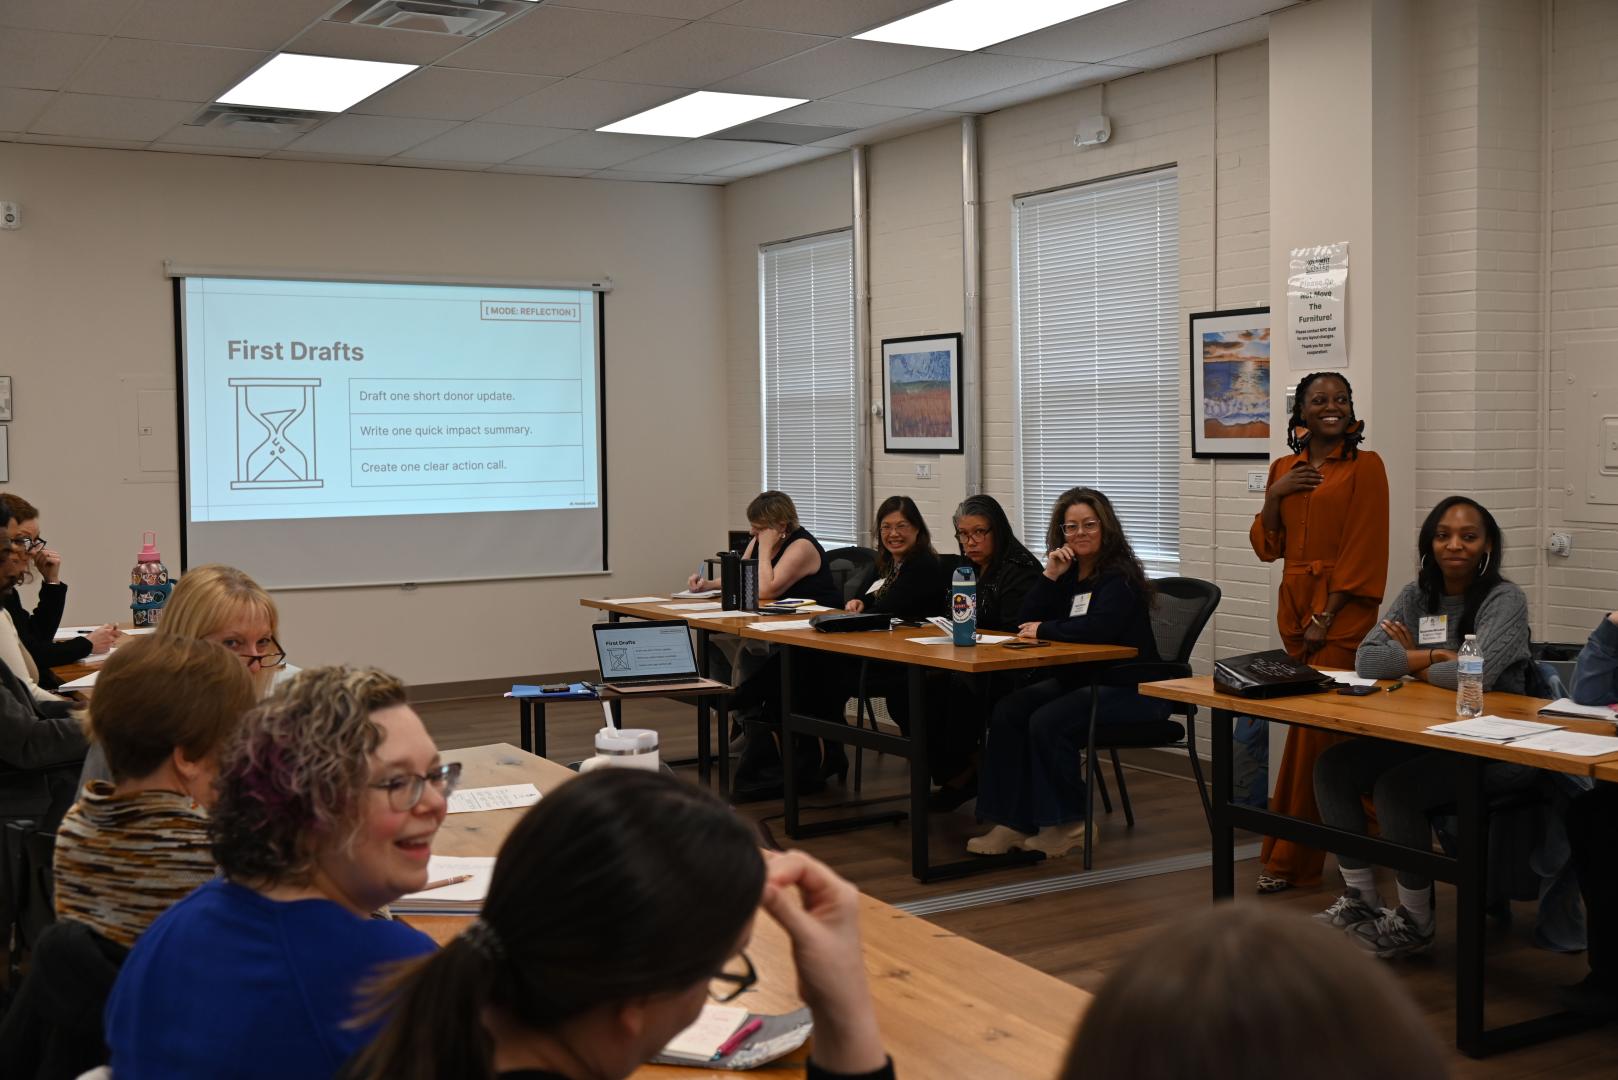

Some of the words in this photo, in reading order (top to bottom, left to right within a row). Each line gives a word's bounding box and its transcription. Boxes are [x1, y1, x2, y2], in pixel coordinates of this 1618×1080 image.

[490, 306, 519, 316] MODE:
[520, 307, 572, 317] REFLECTION
[1298, 314, 1332, 324] Furniture!
[228, 339, 284, 361] First
[290, 341, 365, 361] Drafts
[359, 390, 387, 401] Draft
[389, 392, 410, 401] one
[412, 391, 441, 401] short
[443, 391, 474, 401] donor
[476, 391, 516, 404] update.
[360, 425, 389, 436] Write
[391, 427, 412, 436] one
[414, 425, 443, 438] quick
[446, 424, 482, 437] impact
[483, 425, 534, 437] summary.
[361, 462, 398, 473] Create
[400, 463, 420, 472] one
[423, 461, 450, 471] clear
[452, 460, 484, 471] action
[486, 459, 508, 470] call.
